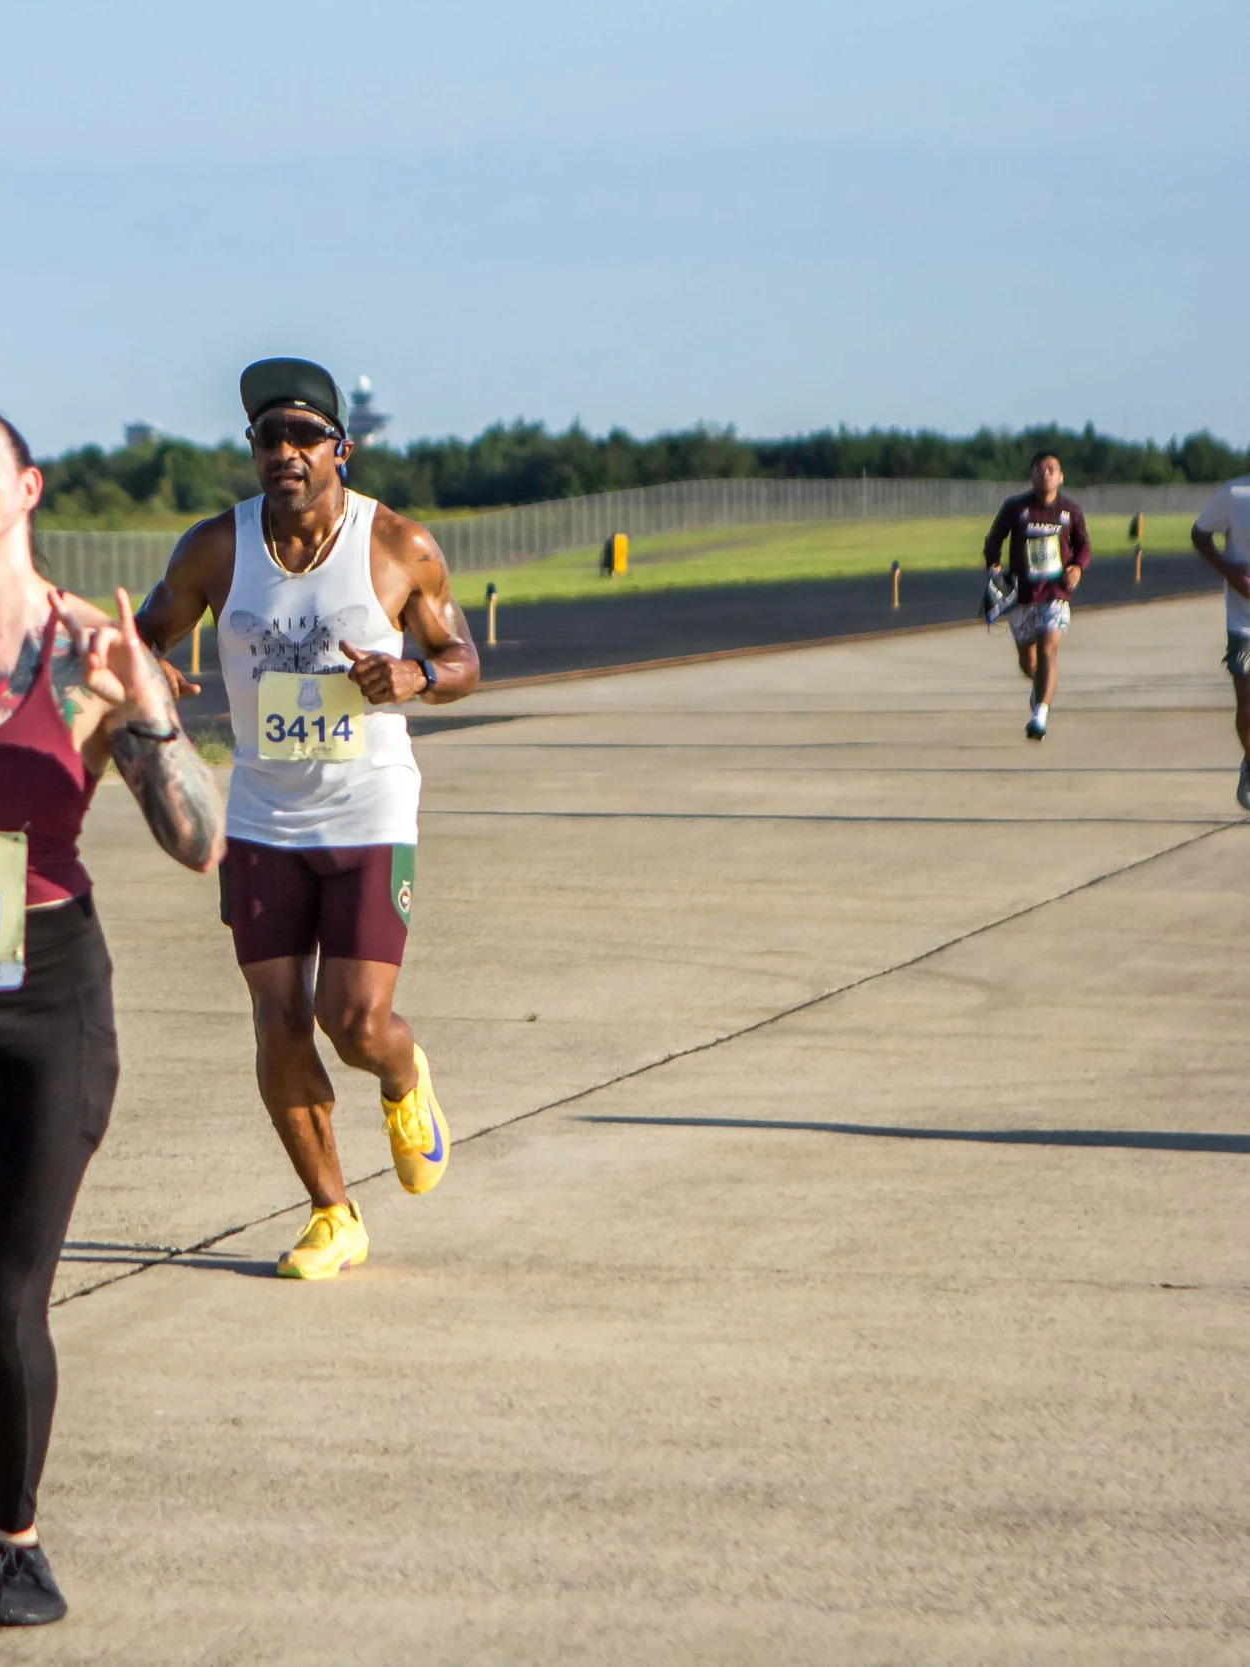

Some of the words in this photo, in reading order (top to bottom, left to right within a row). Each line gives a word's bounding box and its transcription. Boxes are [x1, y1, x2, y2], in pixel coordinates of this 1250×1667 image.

[1027, 522, 1062, 533] BANDIT
[272, 615, 320, 631] NIKE
[250, 639, 344, 655] RUNNIN
[265, 713, 353, 743] 3414
